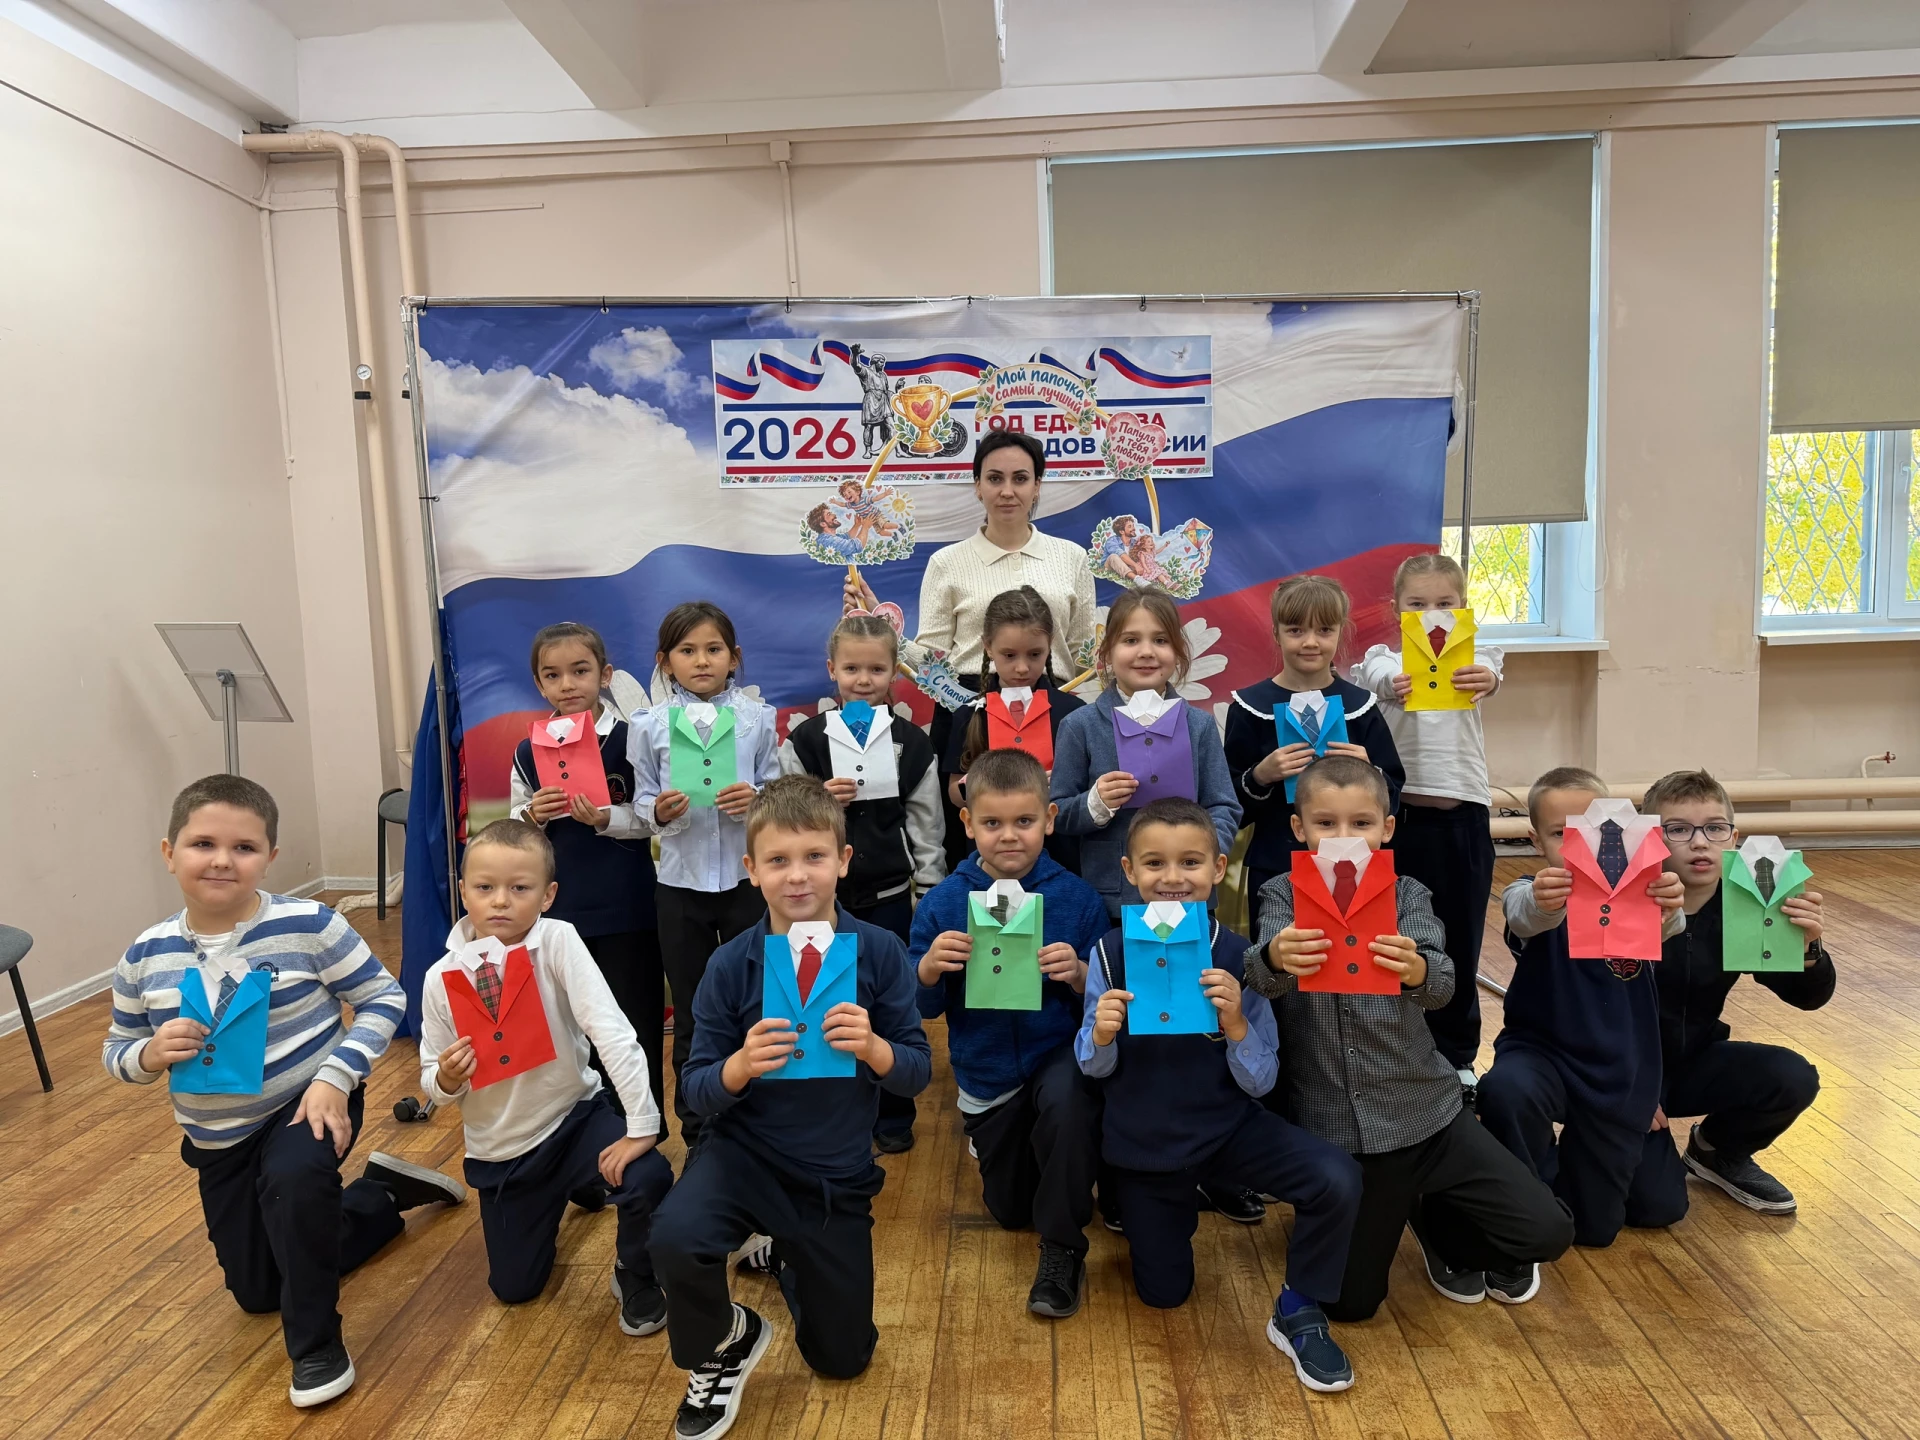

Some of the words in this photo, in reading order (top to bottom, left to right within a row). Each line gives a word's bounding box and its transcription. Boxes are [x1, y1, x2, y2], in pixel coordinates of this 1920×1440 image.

[996, 367, 1026, 389] Мой
[1031, 369, 1085, 401] папочка
[995, 383, 1035, 401] самый
[1037, 386, 1083, 414] лучший
[723, 417, 856, 460] 2026
[1118, 421, 1157, 446] Папуля,
[1127, 438, 1150, 455] тебя
[1113, 444, 1146, 464] люблю
